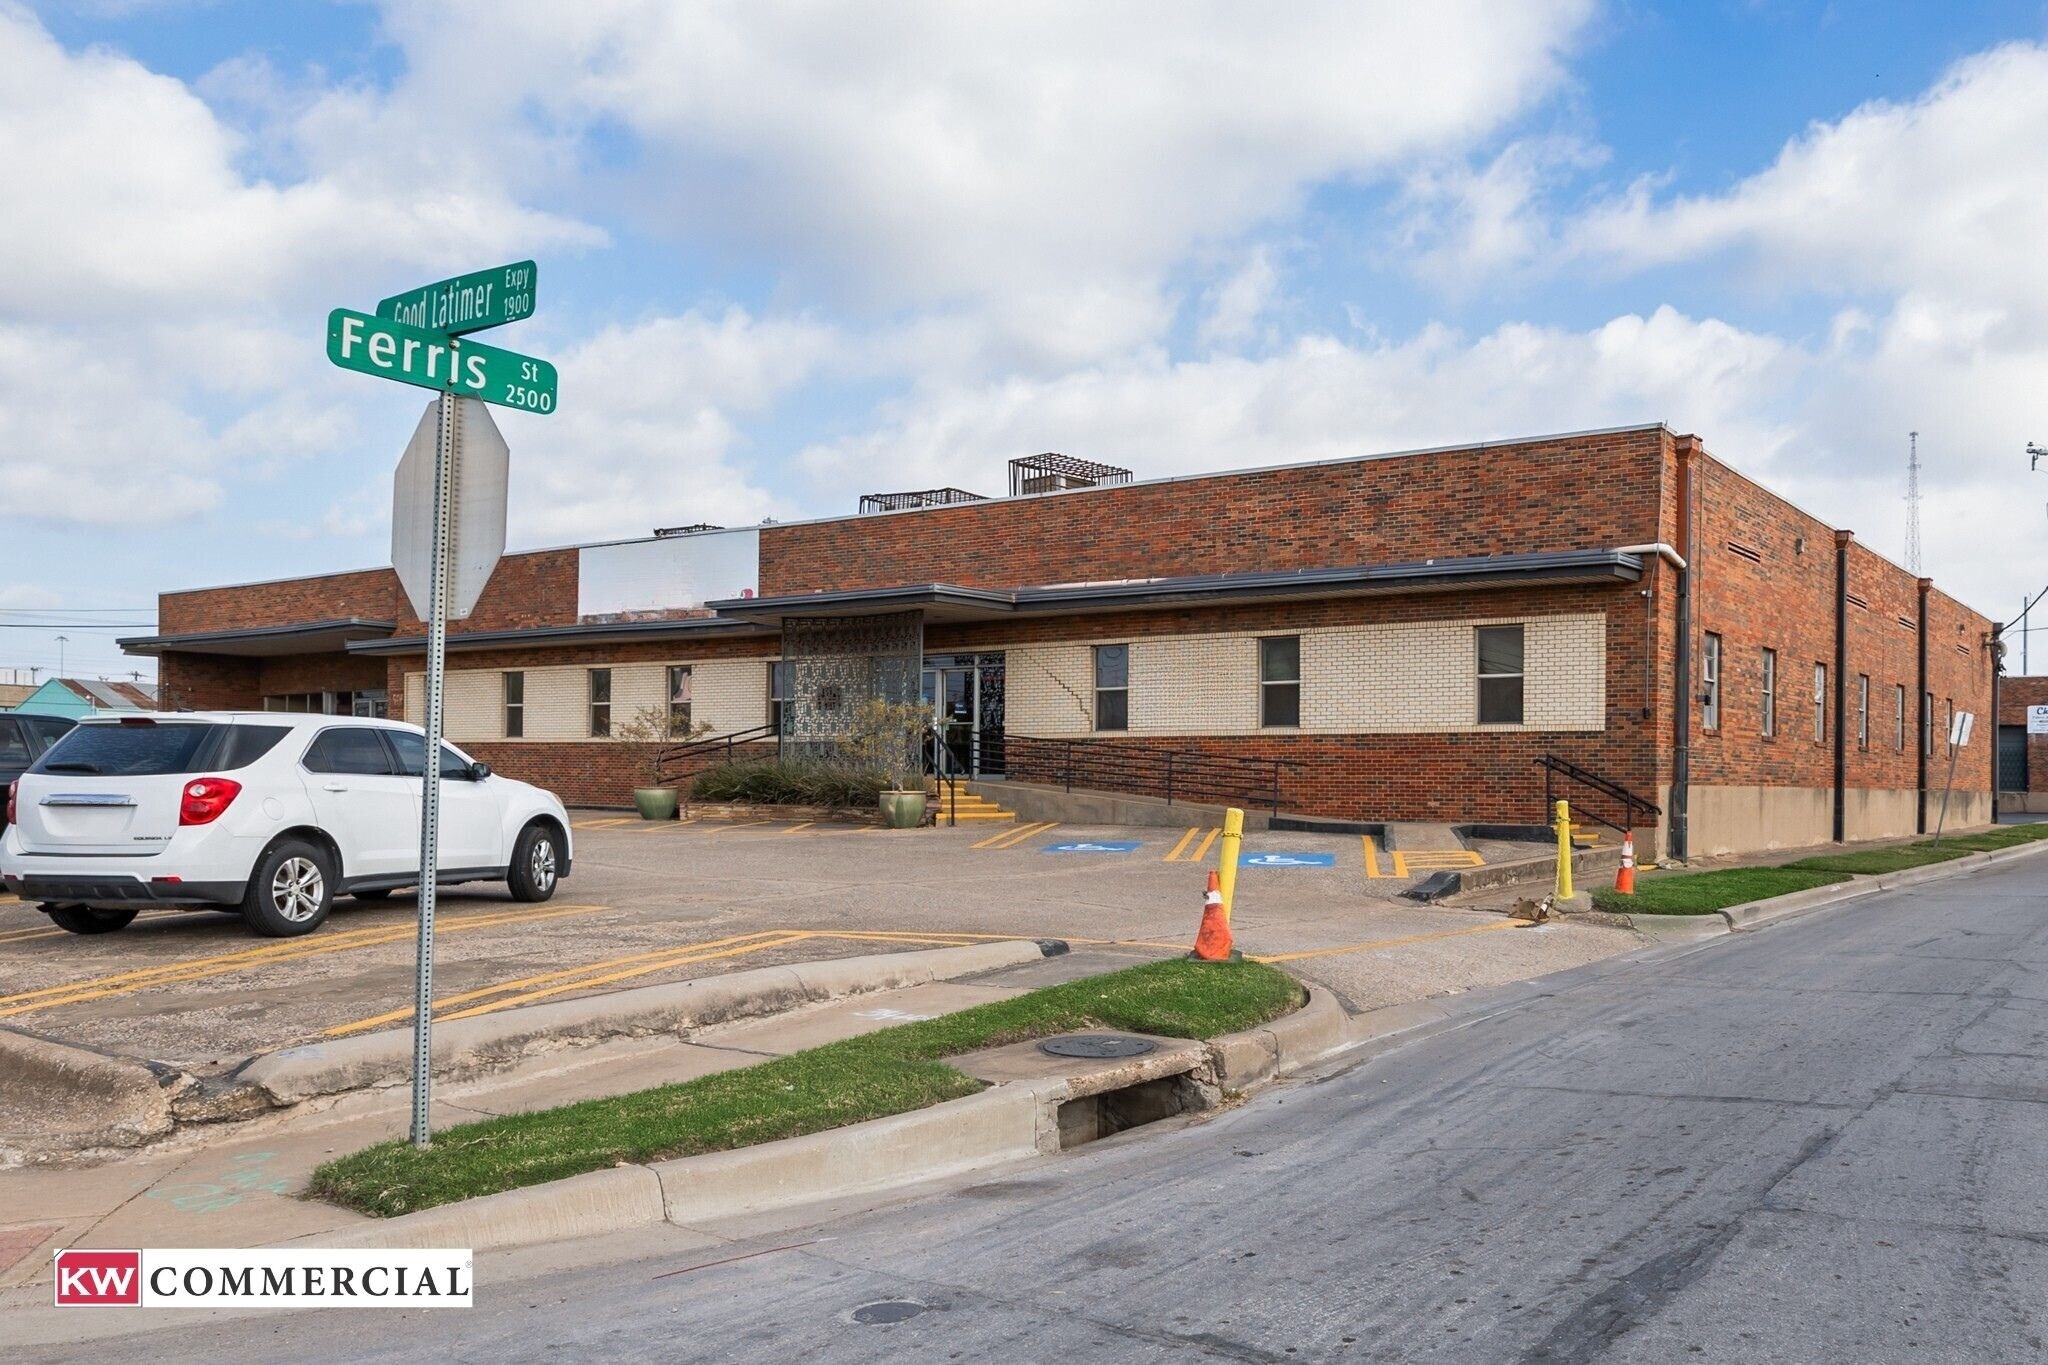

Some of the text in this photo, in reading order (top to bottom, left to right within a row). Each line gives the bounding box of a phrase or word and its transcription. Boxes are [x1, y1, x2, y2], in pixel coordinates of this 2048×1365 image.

[505, 267, 530, 291] Expy
[431, 280, 493, 329] Latimer
[503, 292, 530, 316] 1900
[341, 316, 487, 390] Ferris
[520, 361, 539, 383] St
[505, 383, 551, 412] 2500
